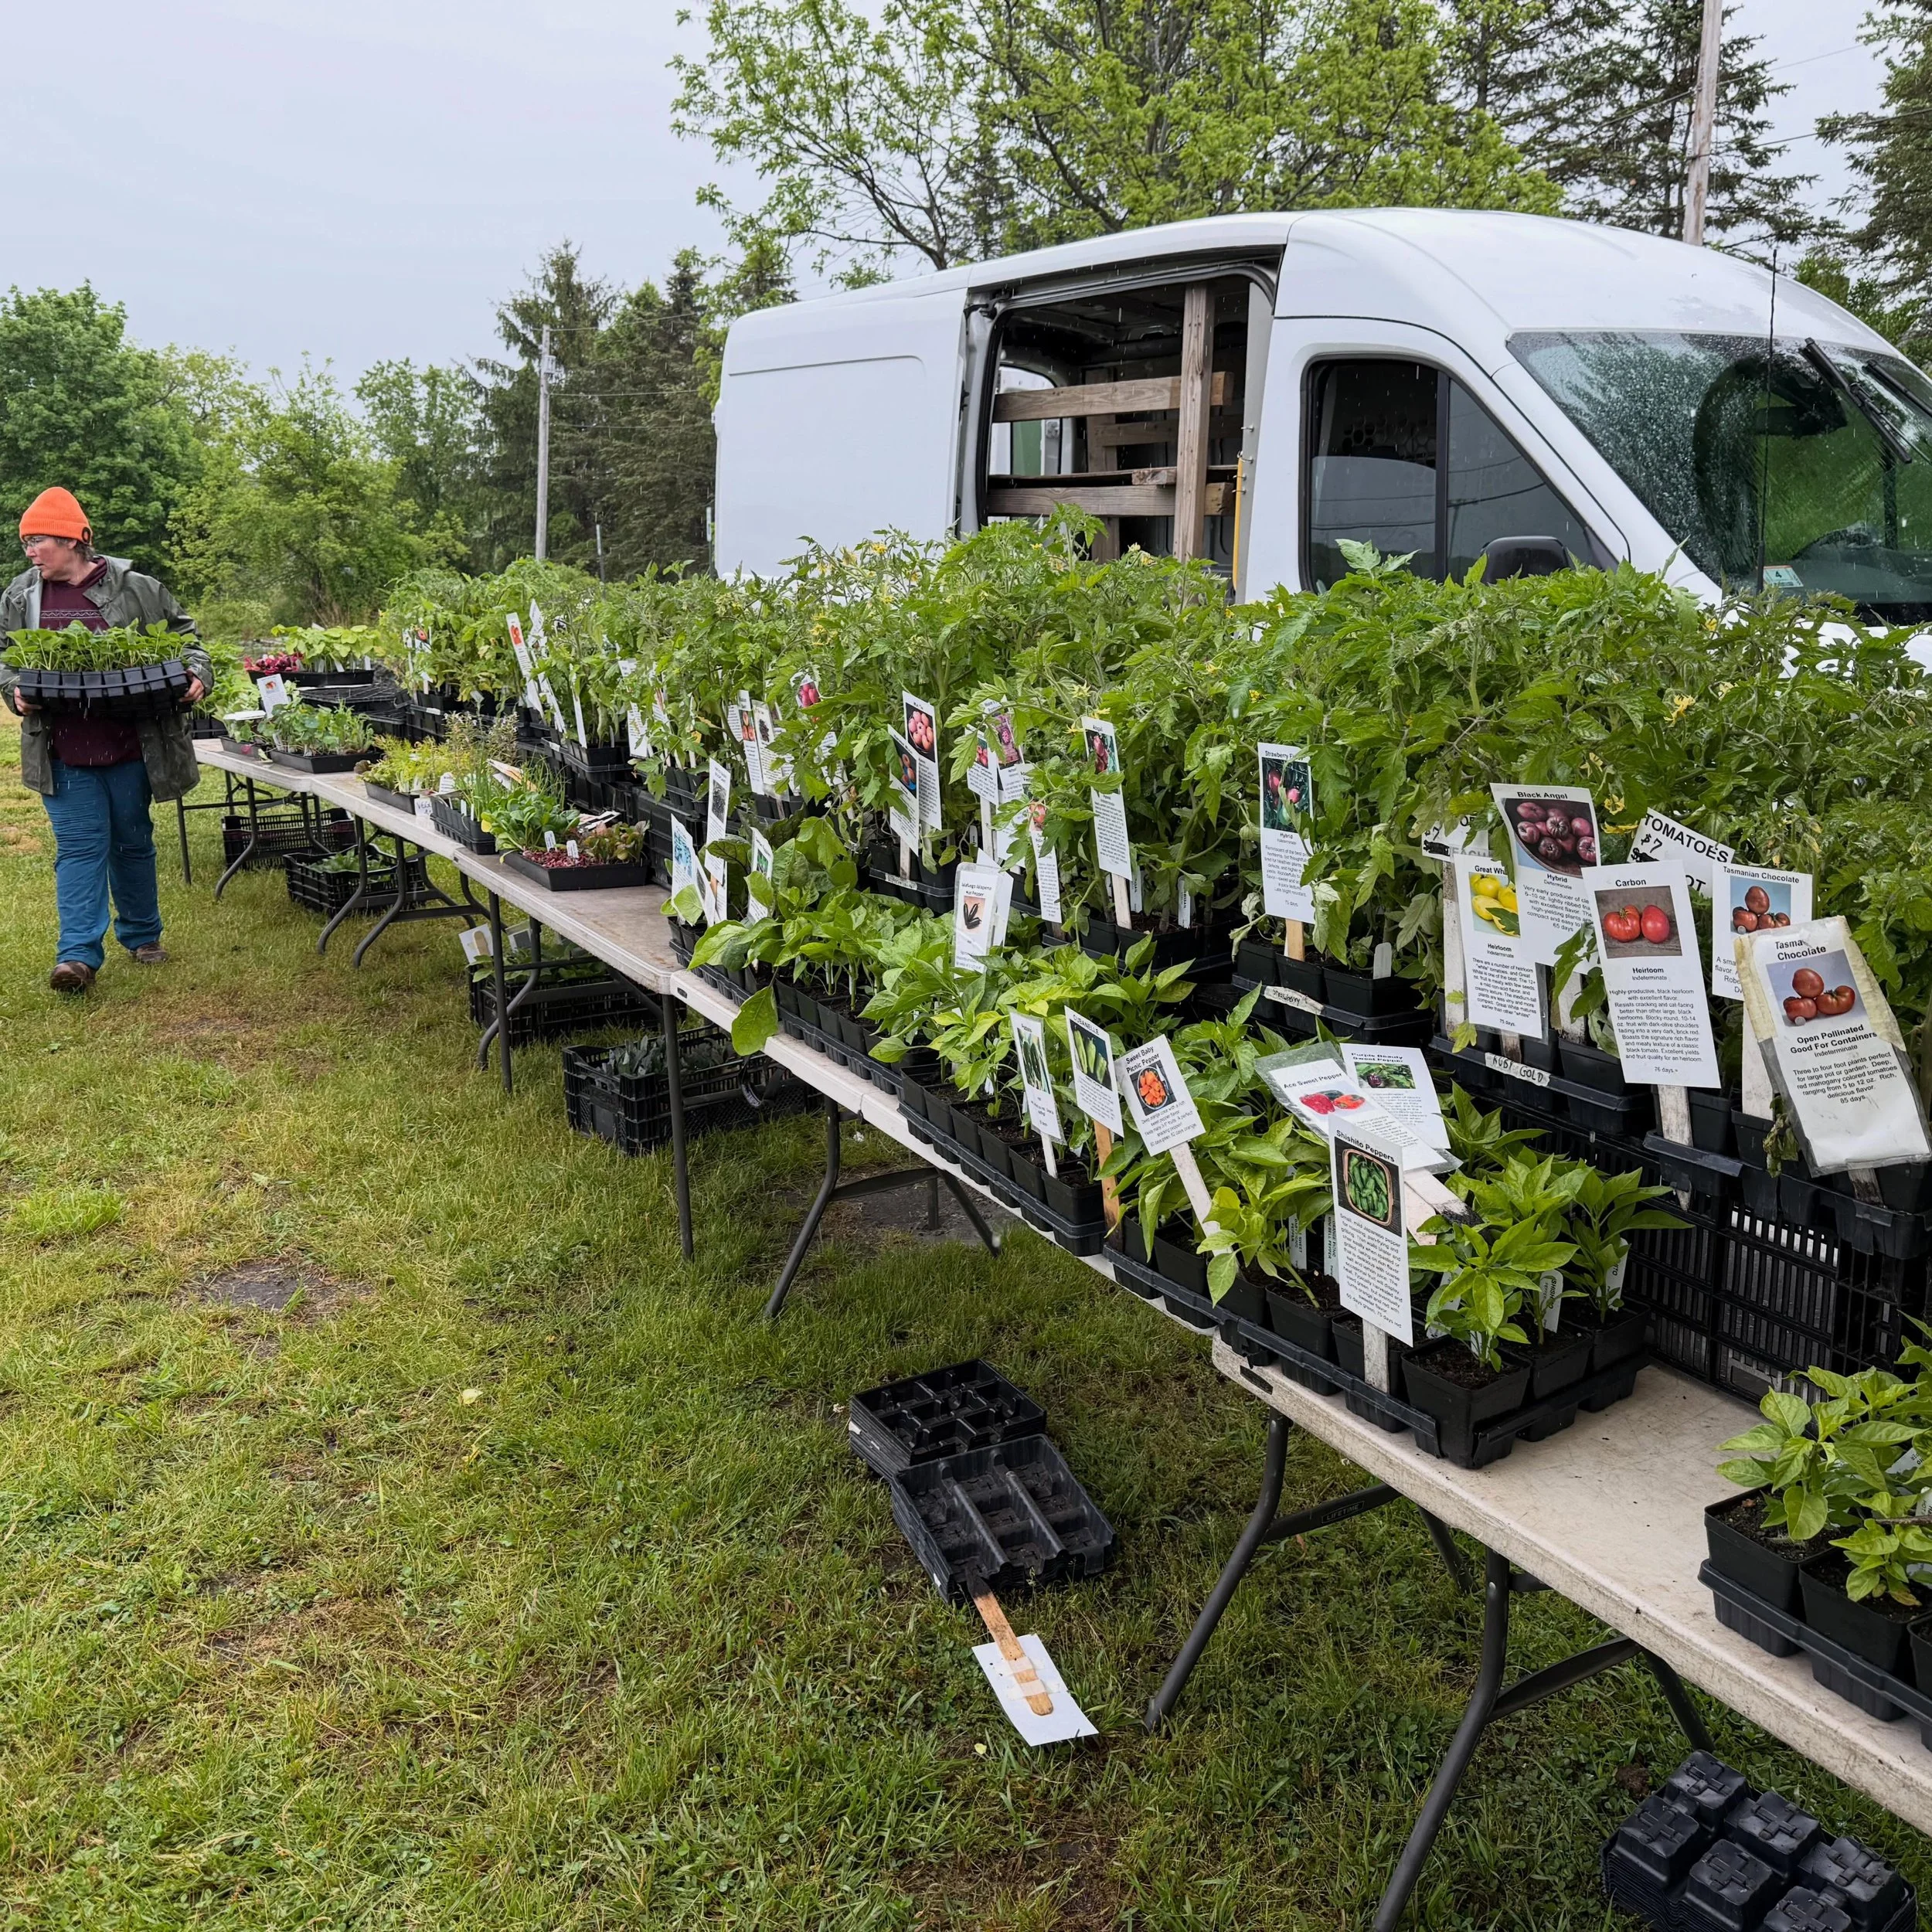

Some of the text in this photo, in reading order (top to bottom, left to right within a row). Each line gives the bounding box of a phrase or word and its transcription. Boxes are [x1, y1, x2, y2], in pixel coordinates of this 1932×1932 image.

[1265, 751, 1288, 760] Strawberry
[1645, 813, 1729, 863] TOMATOES
[1547, 873, 1567, 883] Hybrid
[1723, 866, 1799, 883] Tasmanian Chocolate
[1544, 879, 1572, 889] Determinate
[1615, 879, 1646, 887] Carbon
[1550, 892, 1573, 900] producer
[1488, 944, 1512, 952] Heirloom
[1775, 940, 1803, 950] Tasma
[1777, 946, 1827, 961] Chocolate
[1724, 975, 1740, 984] Robe
[1073, 1015, 1099, 1035] CUBANELLE
[1797, 1024, 1864, 1044] Open Pollinated
[1790, 1046, 1812, 1054] Good
[1831, 1032, 1877, 1047] Containers
[1126, 1046, 1153, 1064] Sweet Baby
[1815, 1045, 1858, 1057] Indeterminate
[1127, 1054, 1159, 1073] Picnic Pepper
[1848, 1057, 1867, 1066] plants
[1869, 1052, 1891, 1062] perfect
[1318, 1073, 1342, 1081] Pepper
[1520, 1066, 1543, 1082] GOLD
[1808, 1078, 1841, 1088] mahogany
[1842, 1073, 1866, 1081] colored
[1867, 1066, 1897, 1076] tomatoes
[1844, 1064, 1868, 1076] garden.
[1802, 1087, 1825, 1097] ranging
[1828, 1085, 1876, 1099] delicious flavor.
[1337, 1130, 1363, 1148] Shishito
[1366, 1144, 1394, 1162] Peppers
[1548, 1279, 1557, 1309] SHISHO
